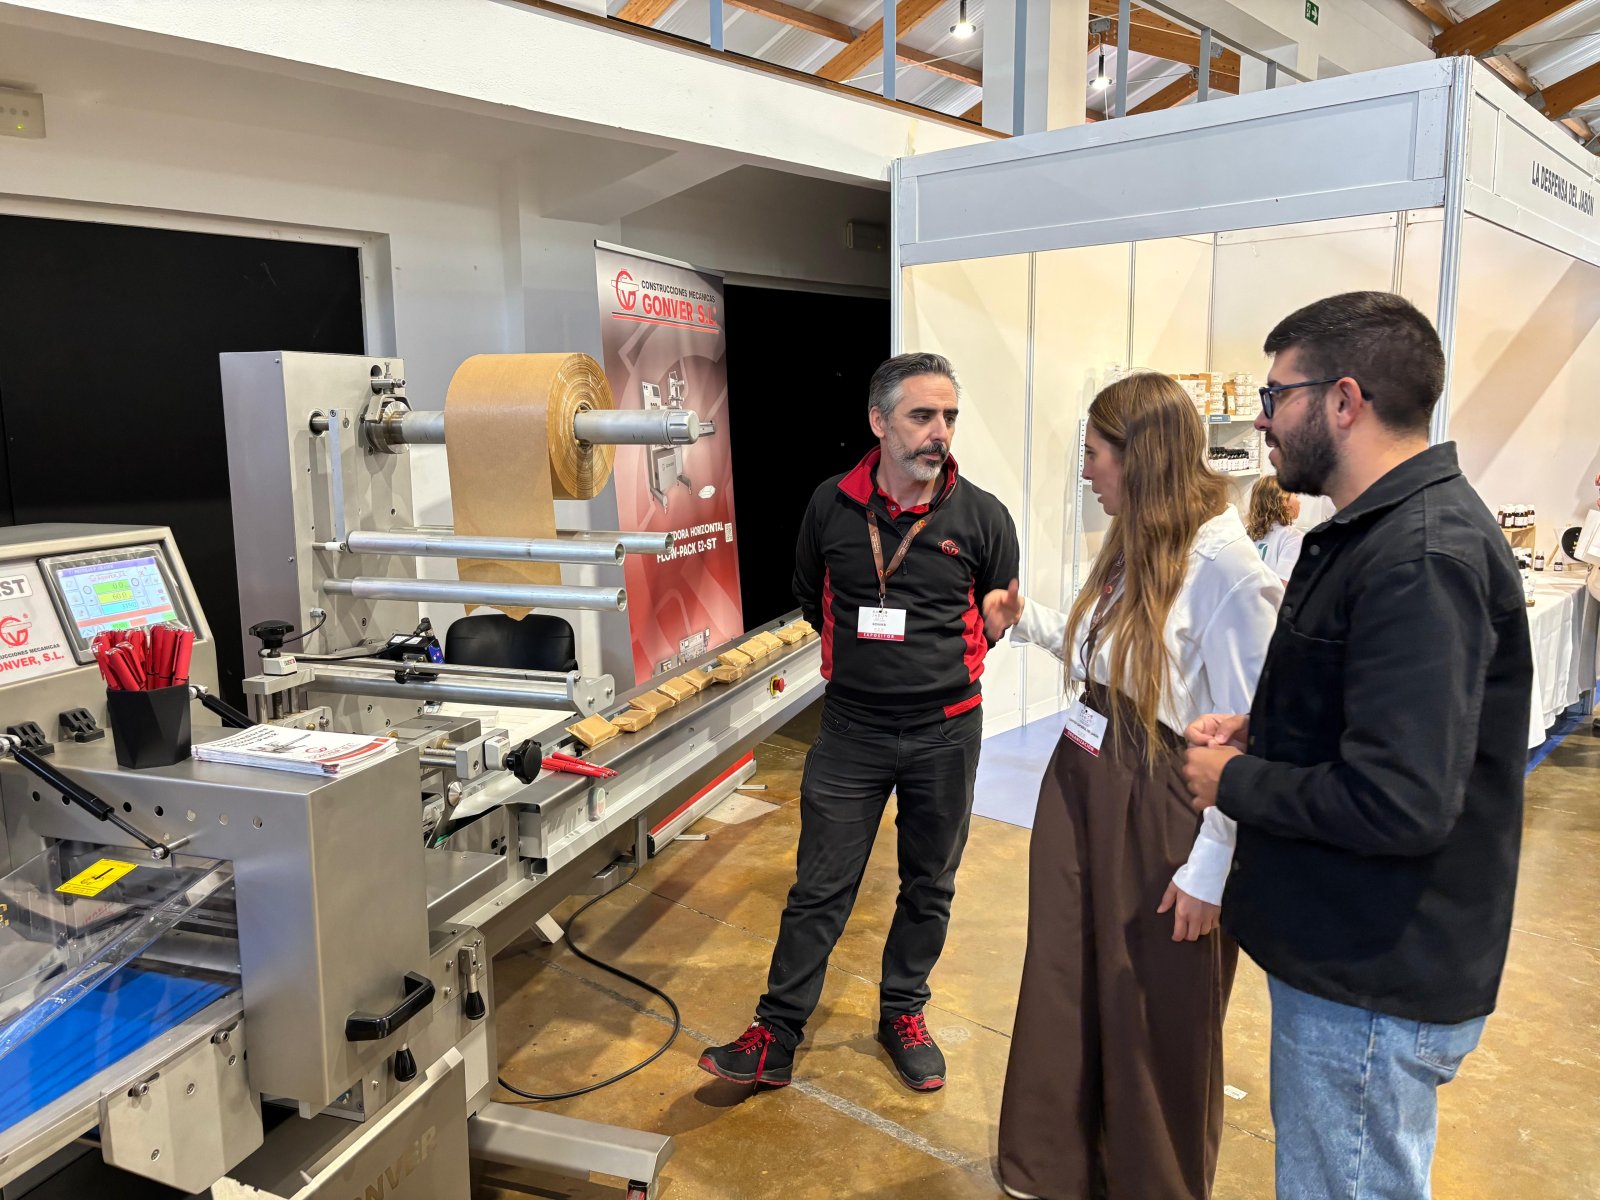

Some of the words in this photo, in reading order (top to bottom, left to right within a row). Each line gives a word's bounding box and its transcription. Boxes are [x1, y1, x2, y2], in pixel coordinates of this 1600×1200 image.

[1532, 161, 1540, 187] LA
[1541, 166, 1568, 203] DESPENSA
[1568, 182, 1578, 209] DEL
[1578, 189, 1595, 217] JABÓN
[641, 280, 688, 298] CONSTRUCCIONES
[642, 293, 694, 321] GONVER
[673, 527, 690, 541] DORA
[690, 521, 724, 537] HORIZONTAL
[697, 537, 718, 553] E2-ST
[0, 578, 25, 597] ST
[0, 649, 29, 660] UCCIONES
[42, 651, 65, 662] S.L.
[353, 1124, 438, 1200] NVER
